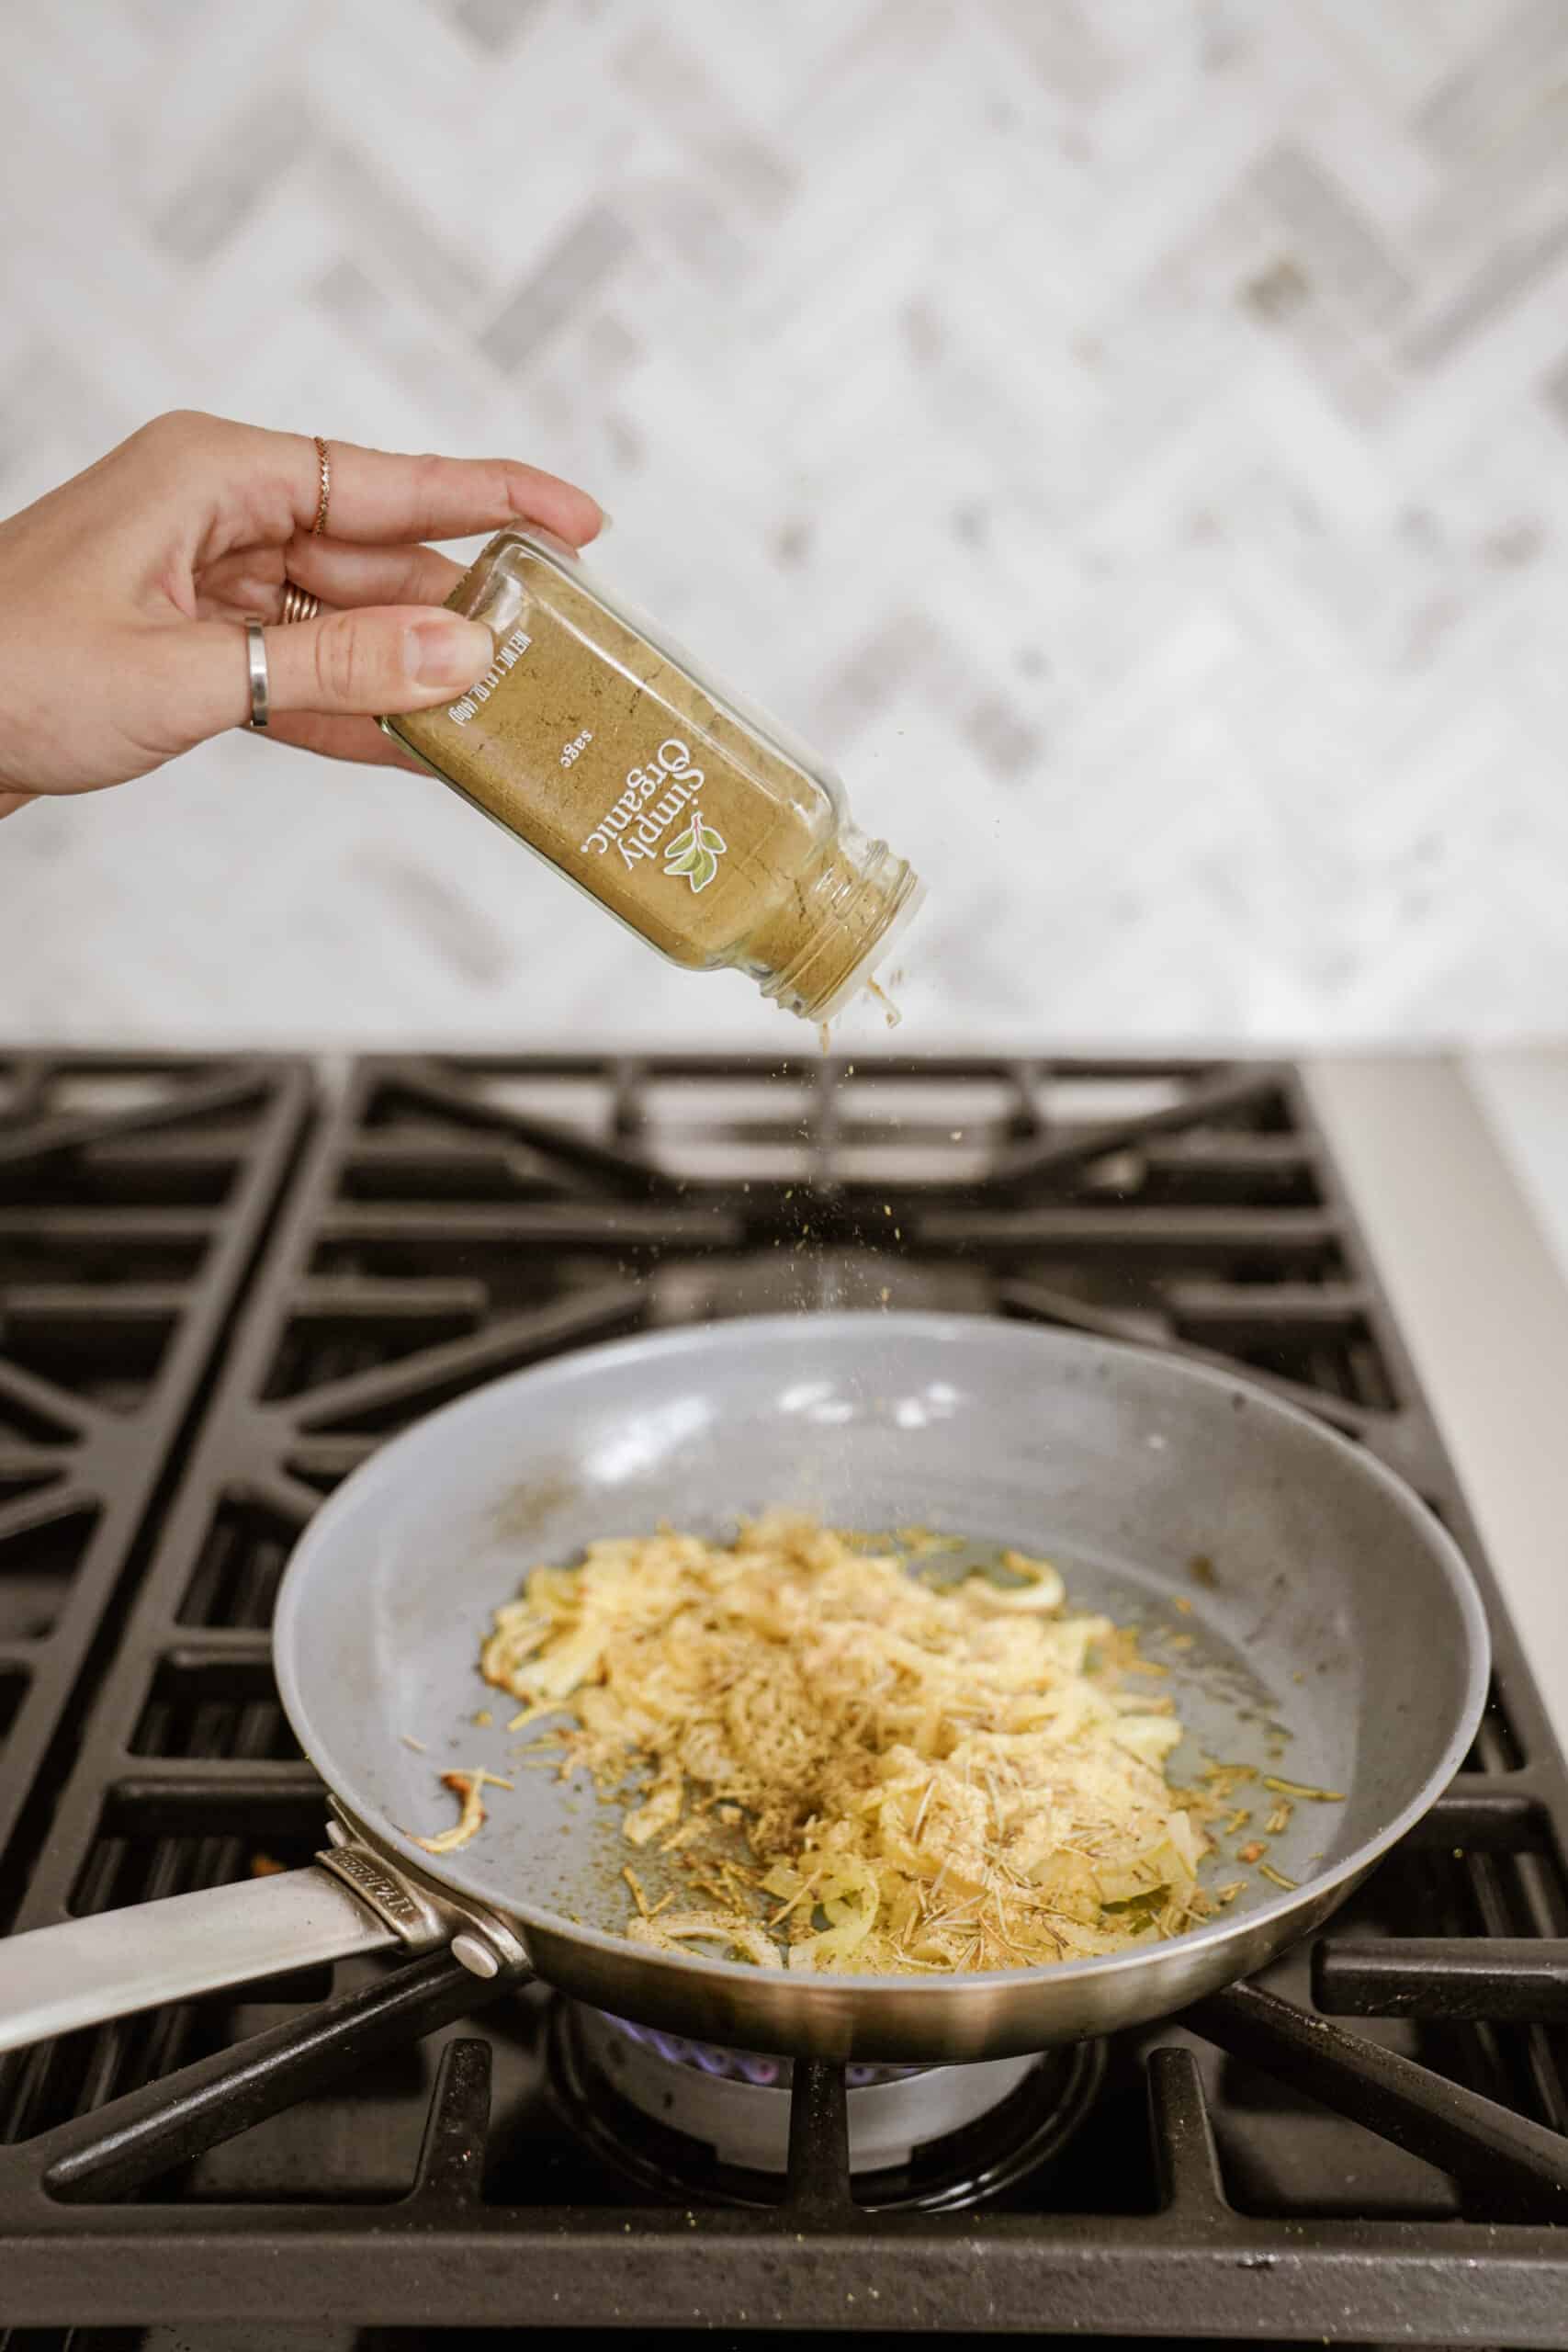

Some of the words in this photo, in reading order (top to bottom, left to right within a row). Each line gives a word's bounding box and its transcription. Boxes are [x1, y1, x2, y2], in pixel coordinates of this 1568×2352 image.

[509, 630, 531, 654] NET
[560, 729, 592, 767] sage
[616, 768, 705, 870] Simply
